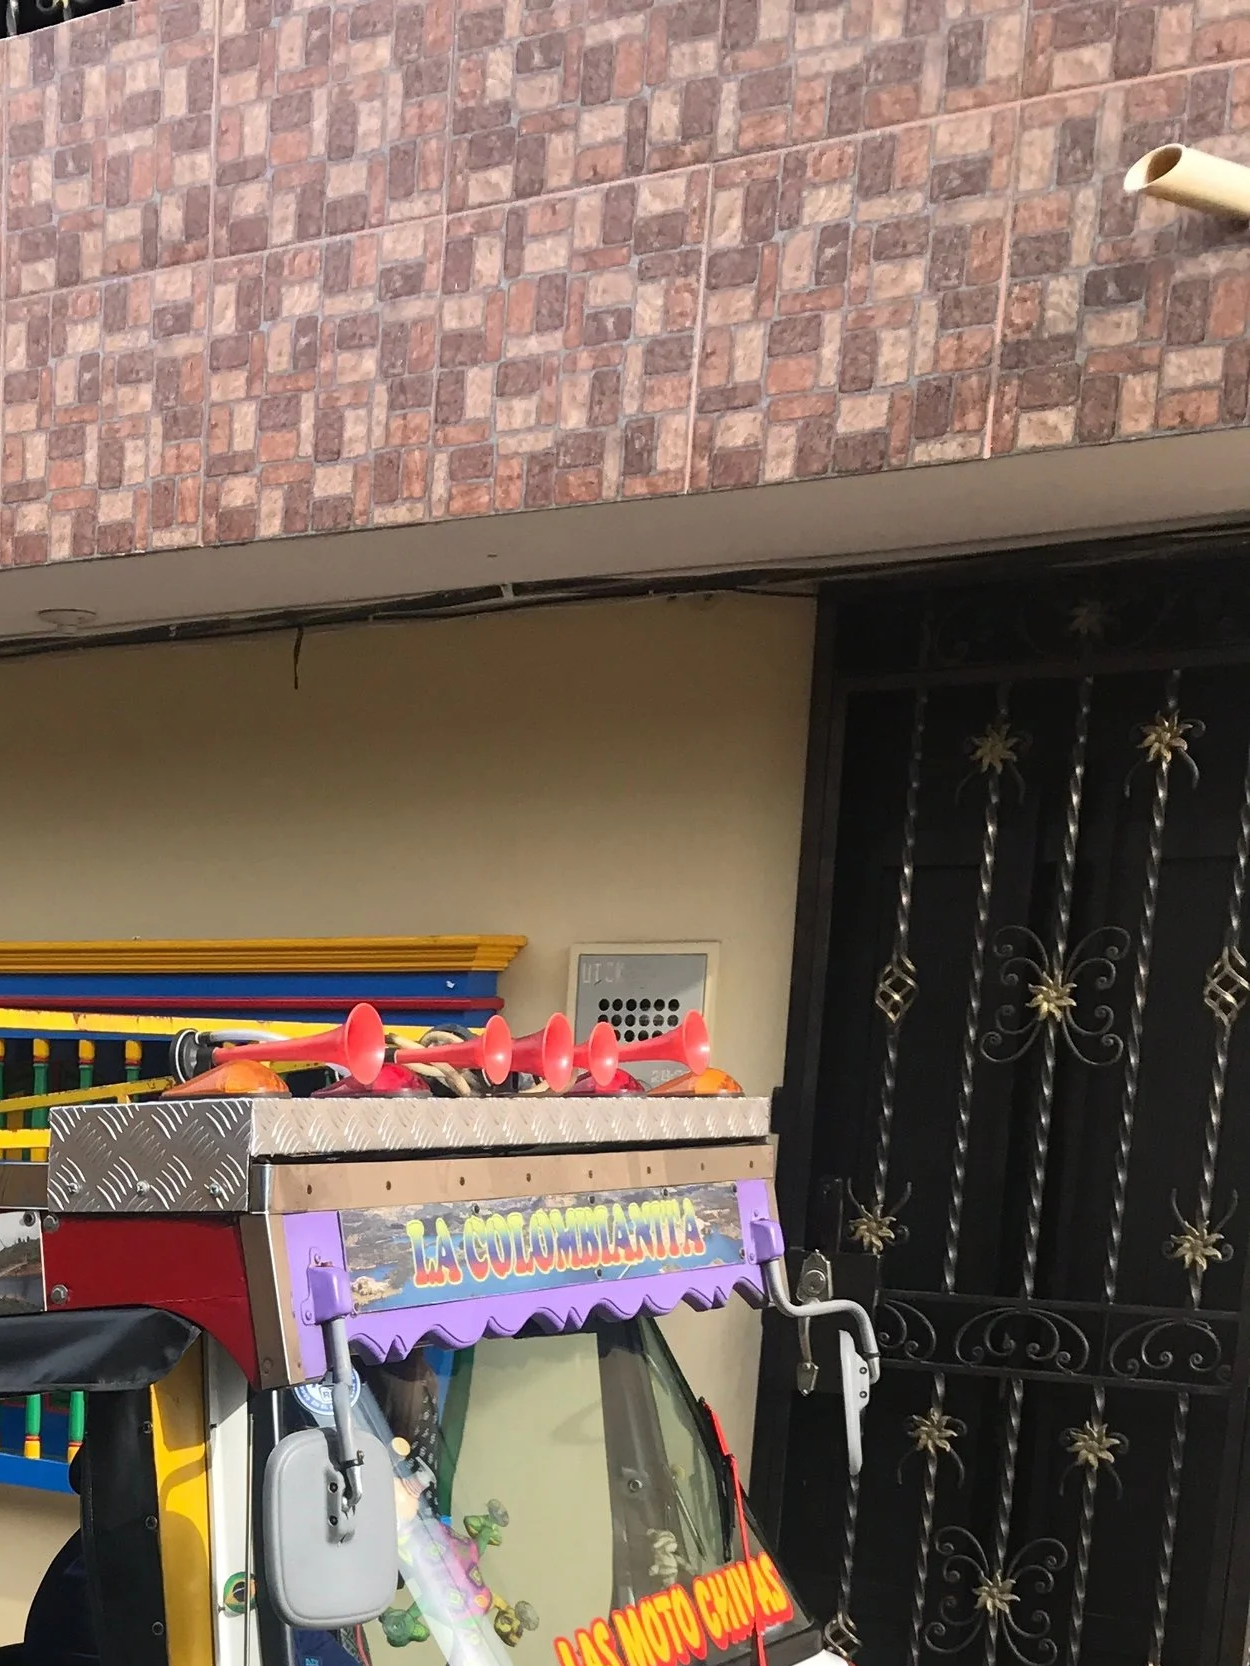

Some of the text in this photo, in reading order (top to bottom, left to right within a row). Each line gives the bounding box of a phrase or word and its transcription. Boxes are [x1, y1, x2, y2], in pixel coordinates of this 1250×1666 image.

[406, 1197, 707, 1288] LA COLOMBIANITA
[694, 1552, 794, 1649] CHIVAS
